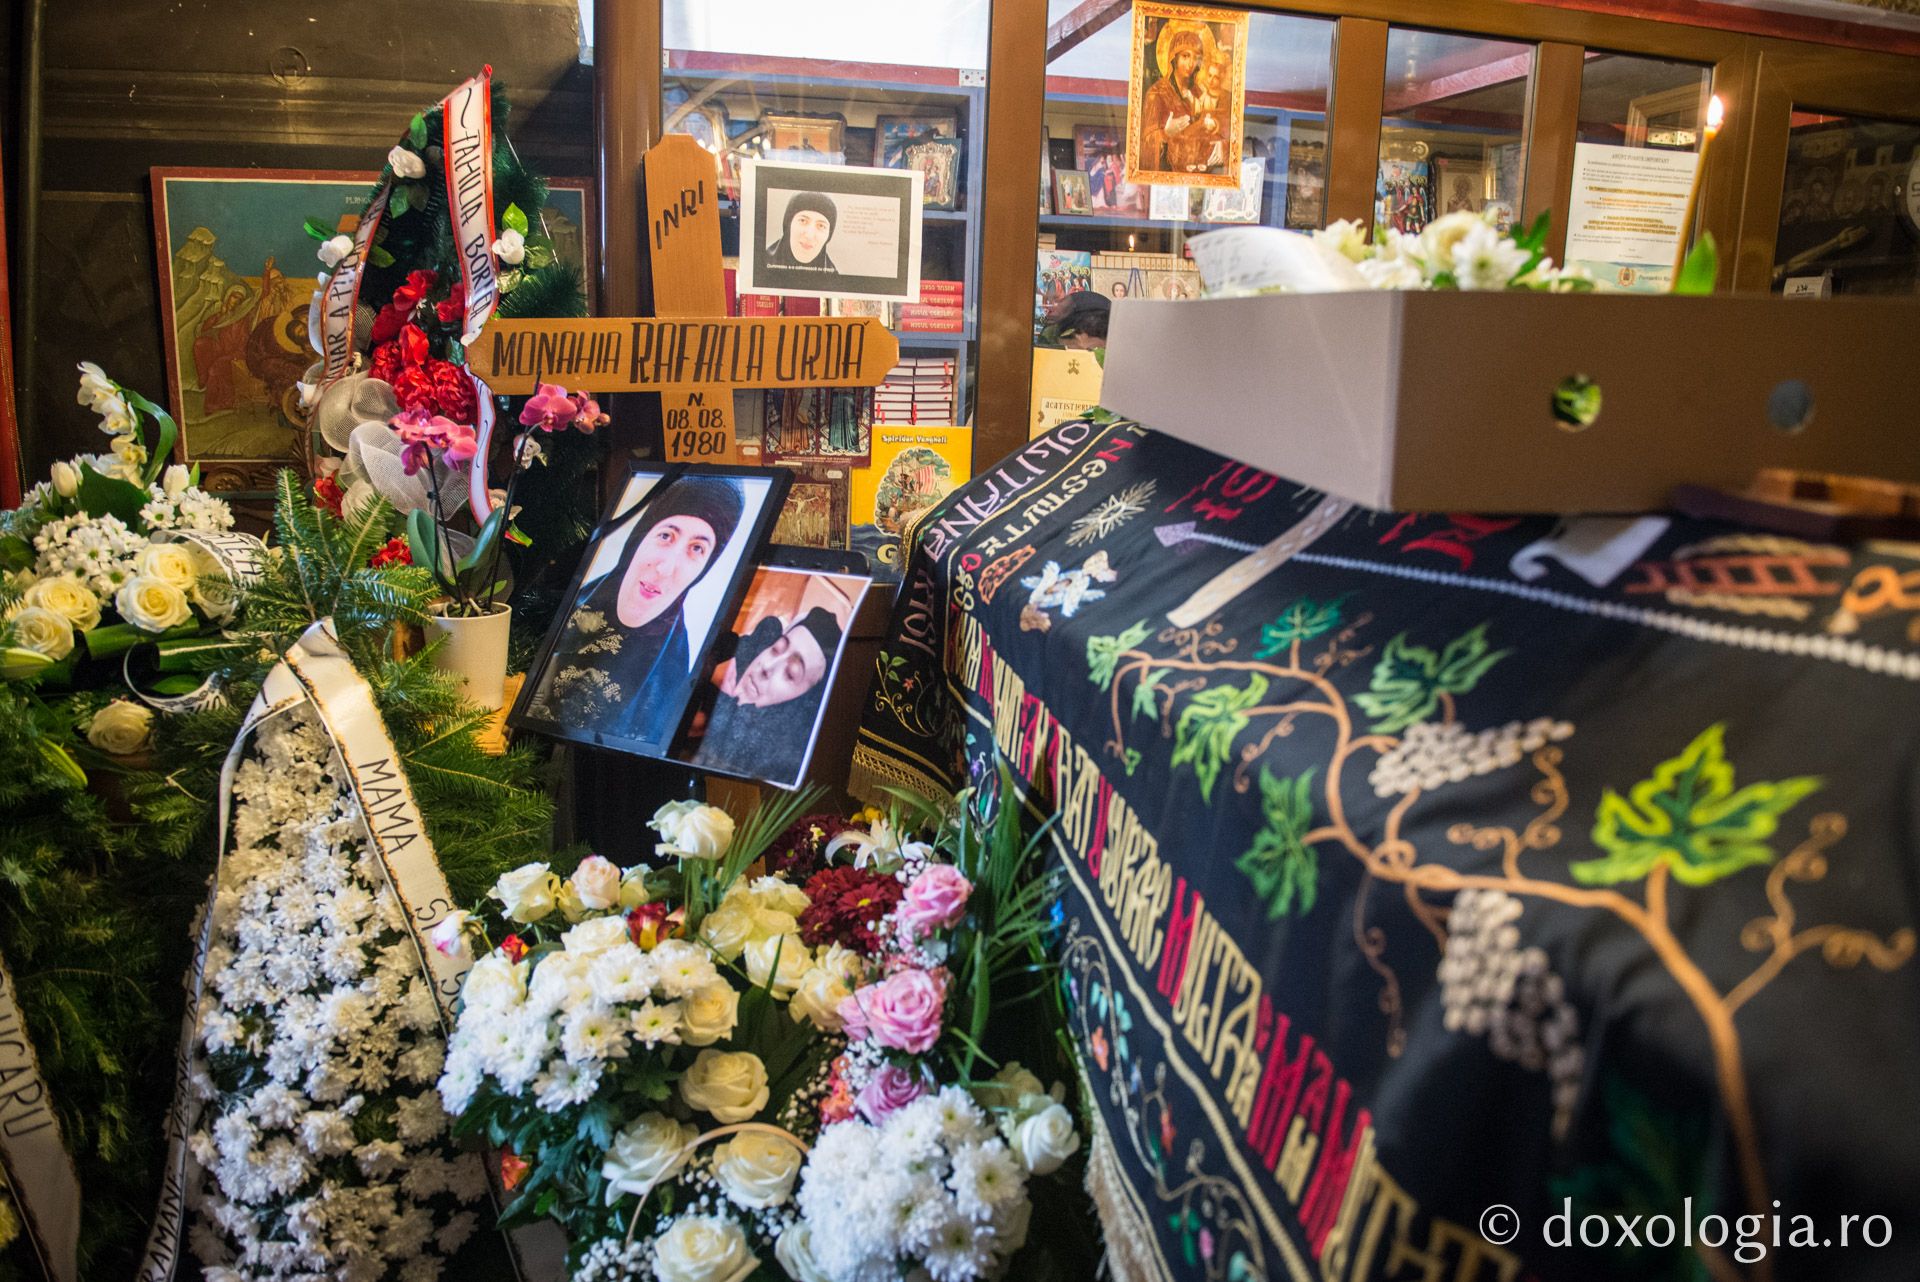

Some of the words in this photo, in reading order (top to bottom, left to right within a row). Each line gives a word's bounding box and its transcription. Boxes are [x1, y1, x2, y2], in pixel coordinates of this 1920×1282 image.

[655, 179, 705, 251] INRI
[491, 330, 623, 377] MONAHIA
[629, 322, 764, 384] RAFAELA
[666, 408, 697, 431] 08.
[698, 407, 727, 430] 08.
[1045, 401, 1095, 412] ACATISTIERU
[670, 430, 727, 458] 1980
[881, 433, 914, 445] Spiridon
[916, 434, 948, 445] Vangheli
[357, 757, 421, 857] MAMA
